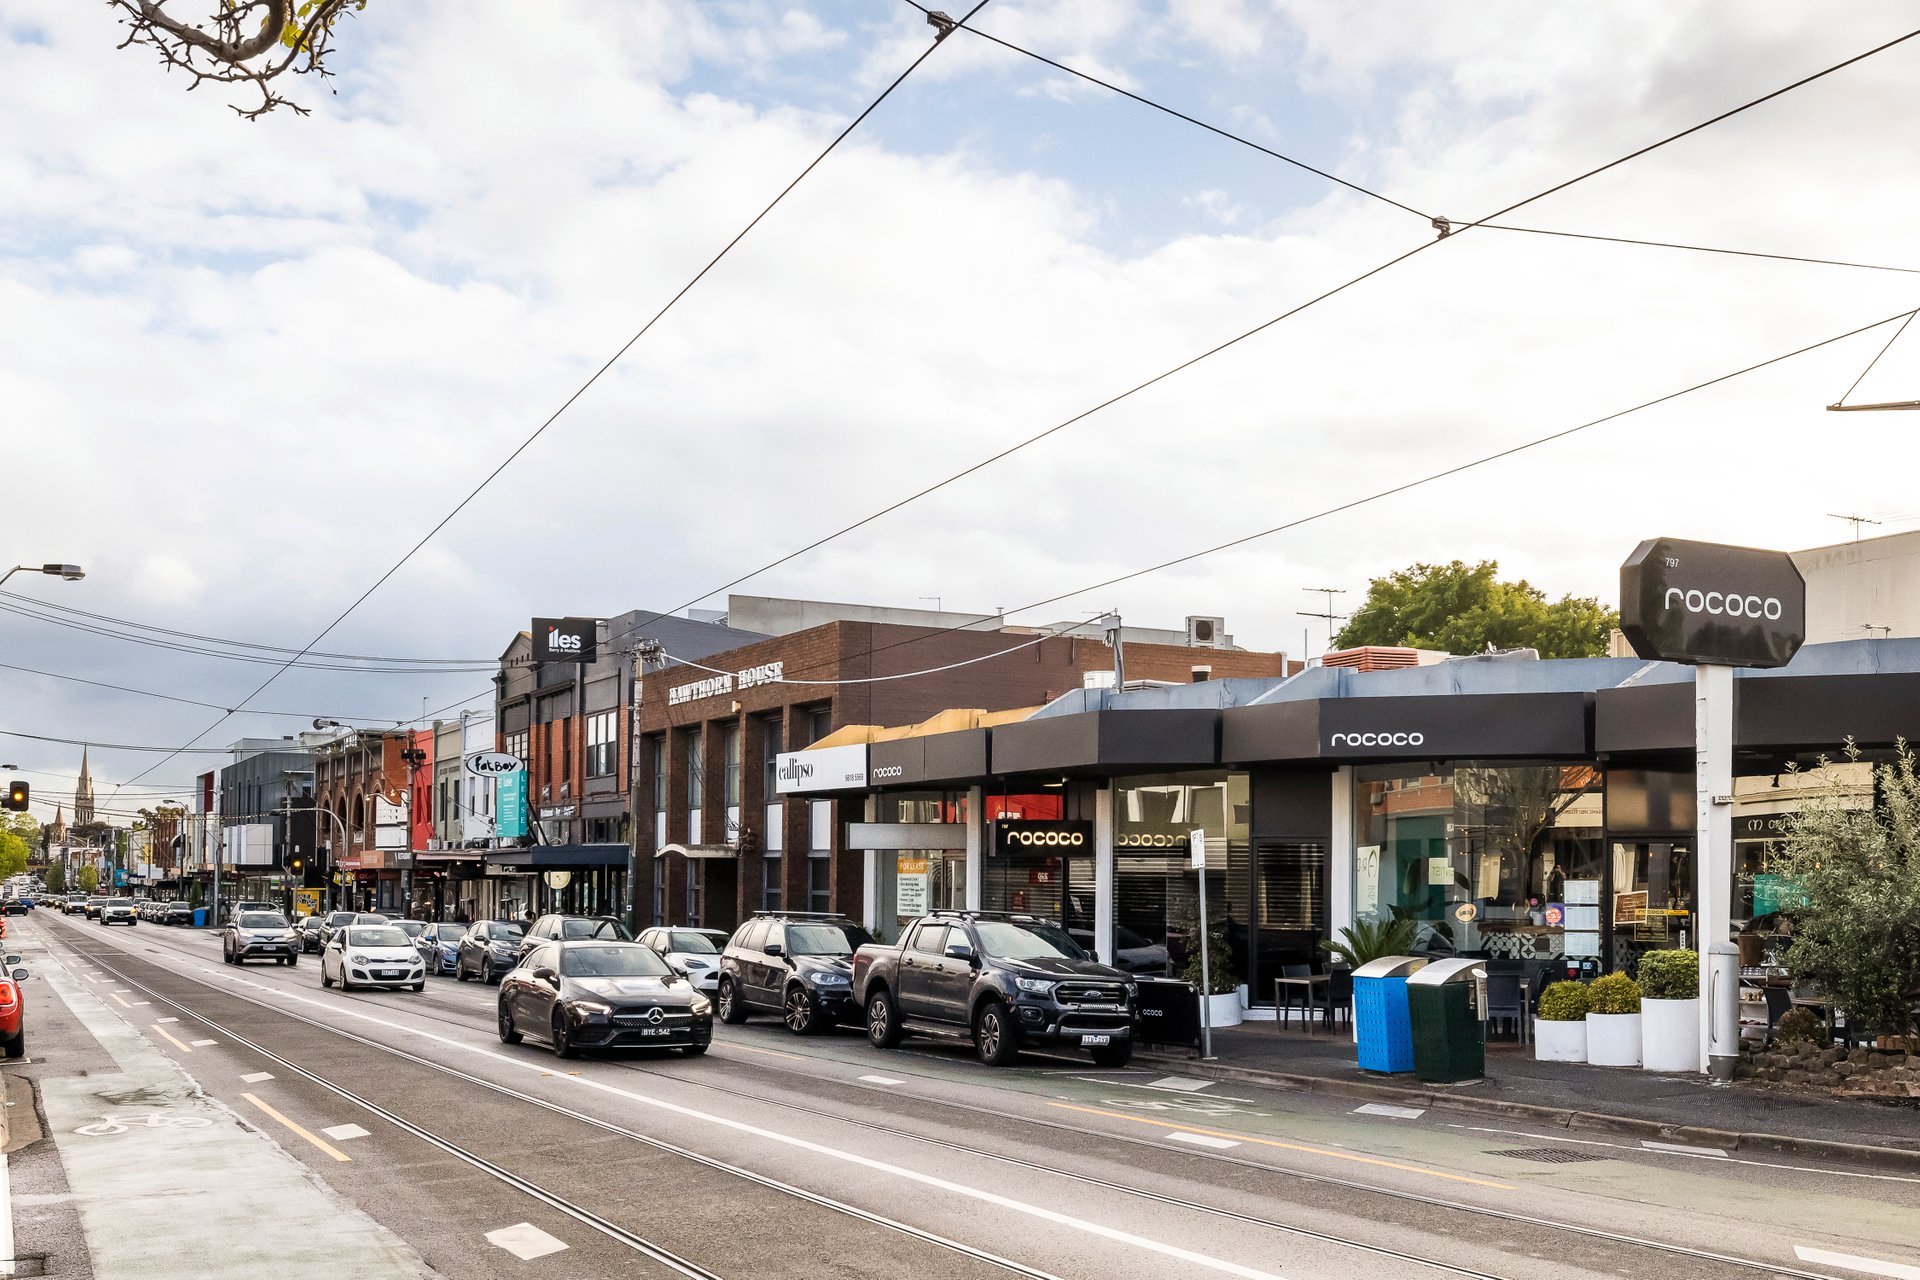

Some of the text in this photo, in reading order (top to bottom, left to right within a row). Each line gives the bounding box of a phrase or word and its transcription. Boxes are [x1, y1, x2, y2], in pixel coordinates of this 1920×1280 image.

[1665, 557, 1680, 568] 797
[1664, 587, 1782, 620] rococo
[548, 625, 582, 649] iles
[668, 661, 784, 705] HAWTHORN HOUSE
[1331, 732, 1424, 747] rococo
[778, 757, 814, 786] callipso
[873, 765, 902, 779] rococo
[1007, 831, 1084, 846] rococo
[900, 862, 925, 871] FOR LEASE
